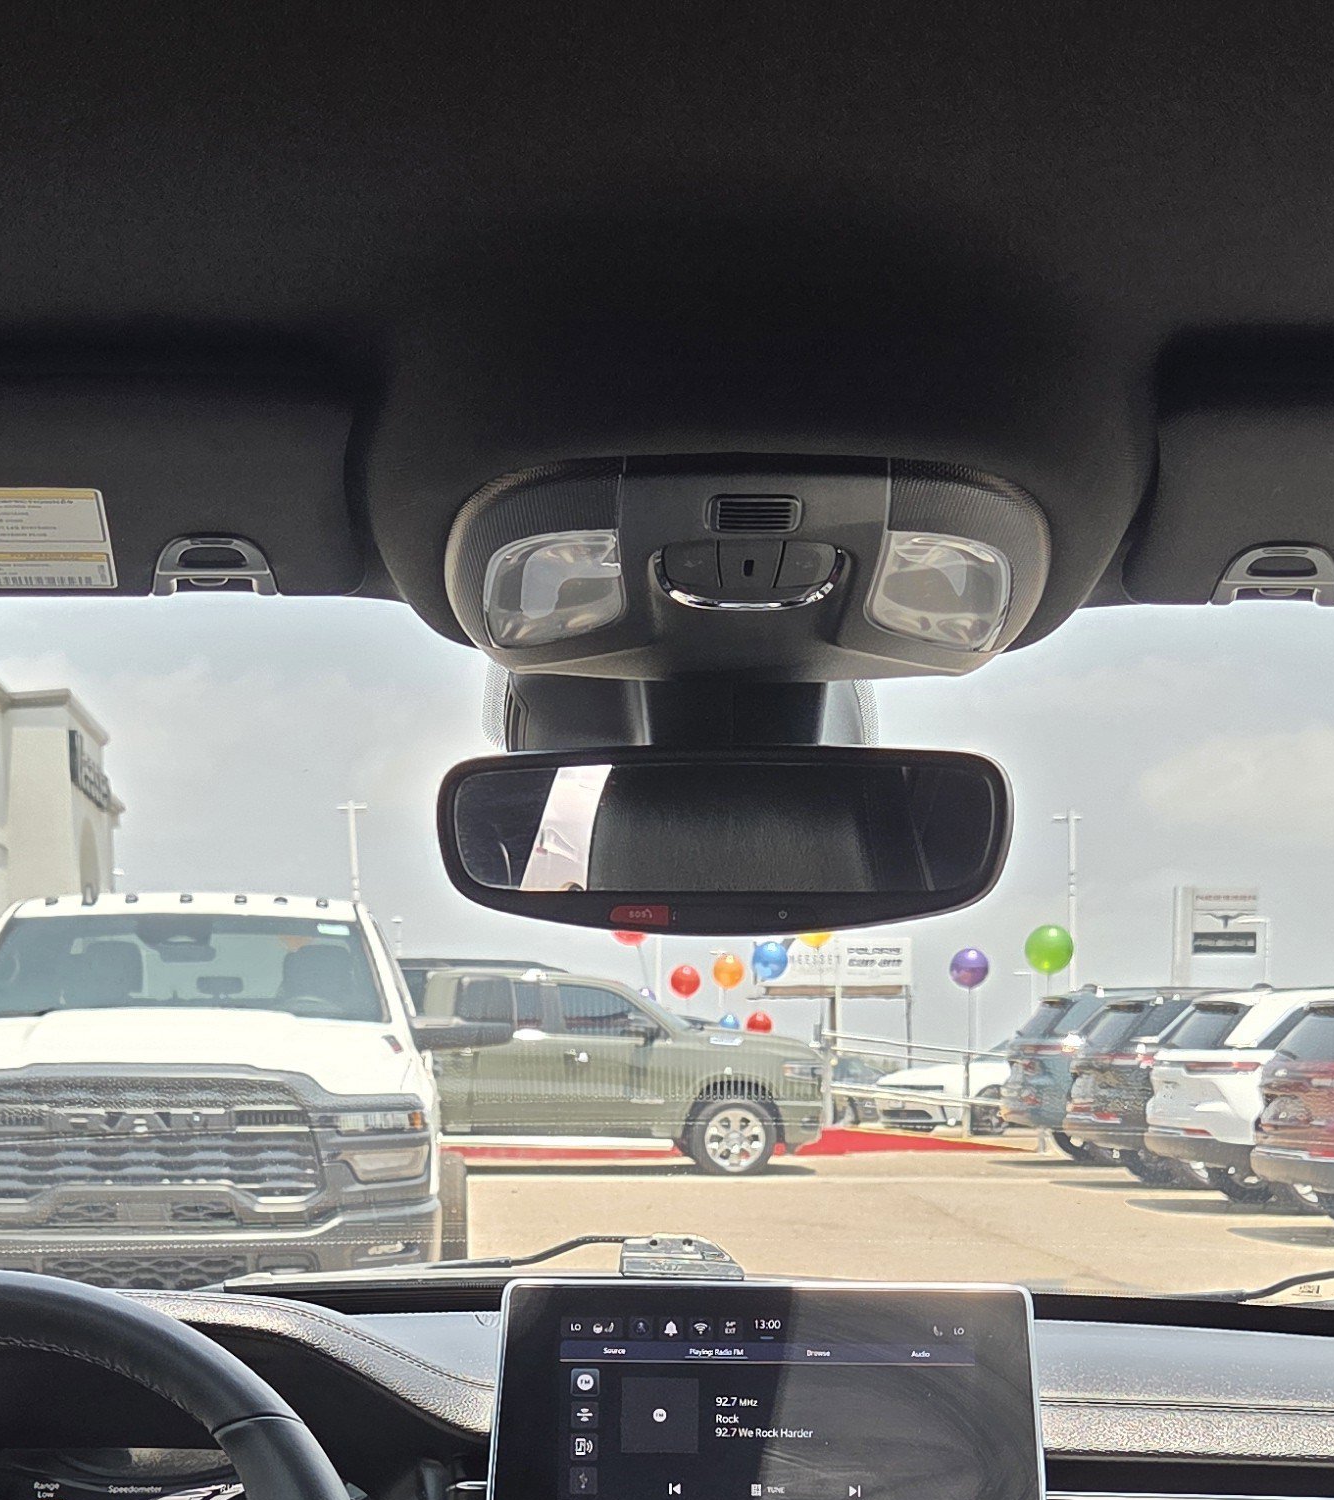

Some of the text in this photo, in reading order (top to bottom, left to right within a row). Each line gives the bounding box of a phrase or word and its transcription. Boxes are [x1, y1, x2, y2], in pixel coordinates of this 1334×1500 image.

[628, 910, 647, 919] SOS
[570, 1323, 582, 1332] LO
[754, 1319, 782, 1330] 13:00
[953, 1327, 965, 1336] LO
[603, 1347, 626, 1355] Source
[911, 1350, 931, 1358] Audio
[715, 1397, 737, 1407] 92.7
[715, 1413, 740, 1424] Rock
[715, 1428, 814, 1438] 92.7 We Rock Harder
[33, 1481, 60, 1491] Range
[108, 1485, 162, 1494] Speedometer
